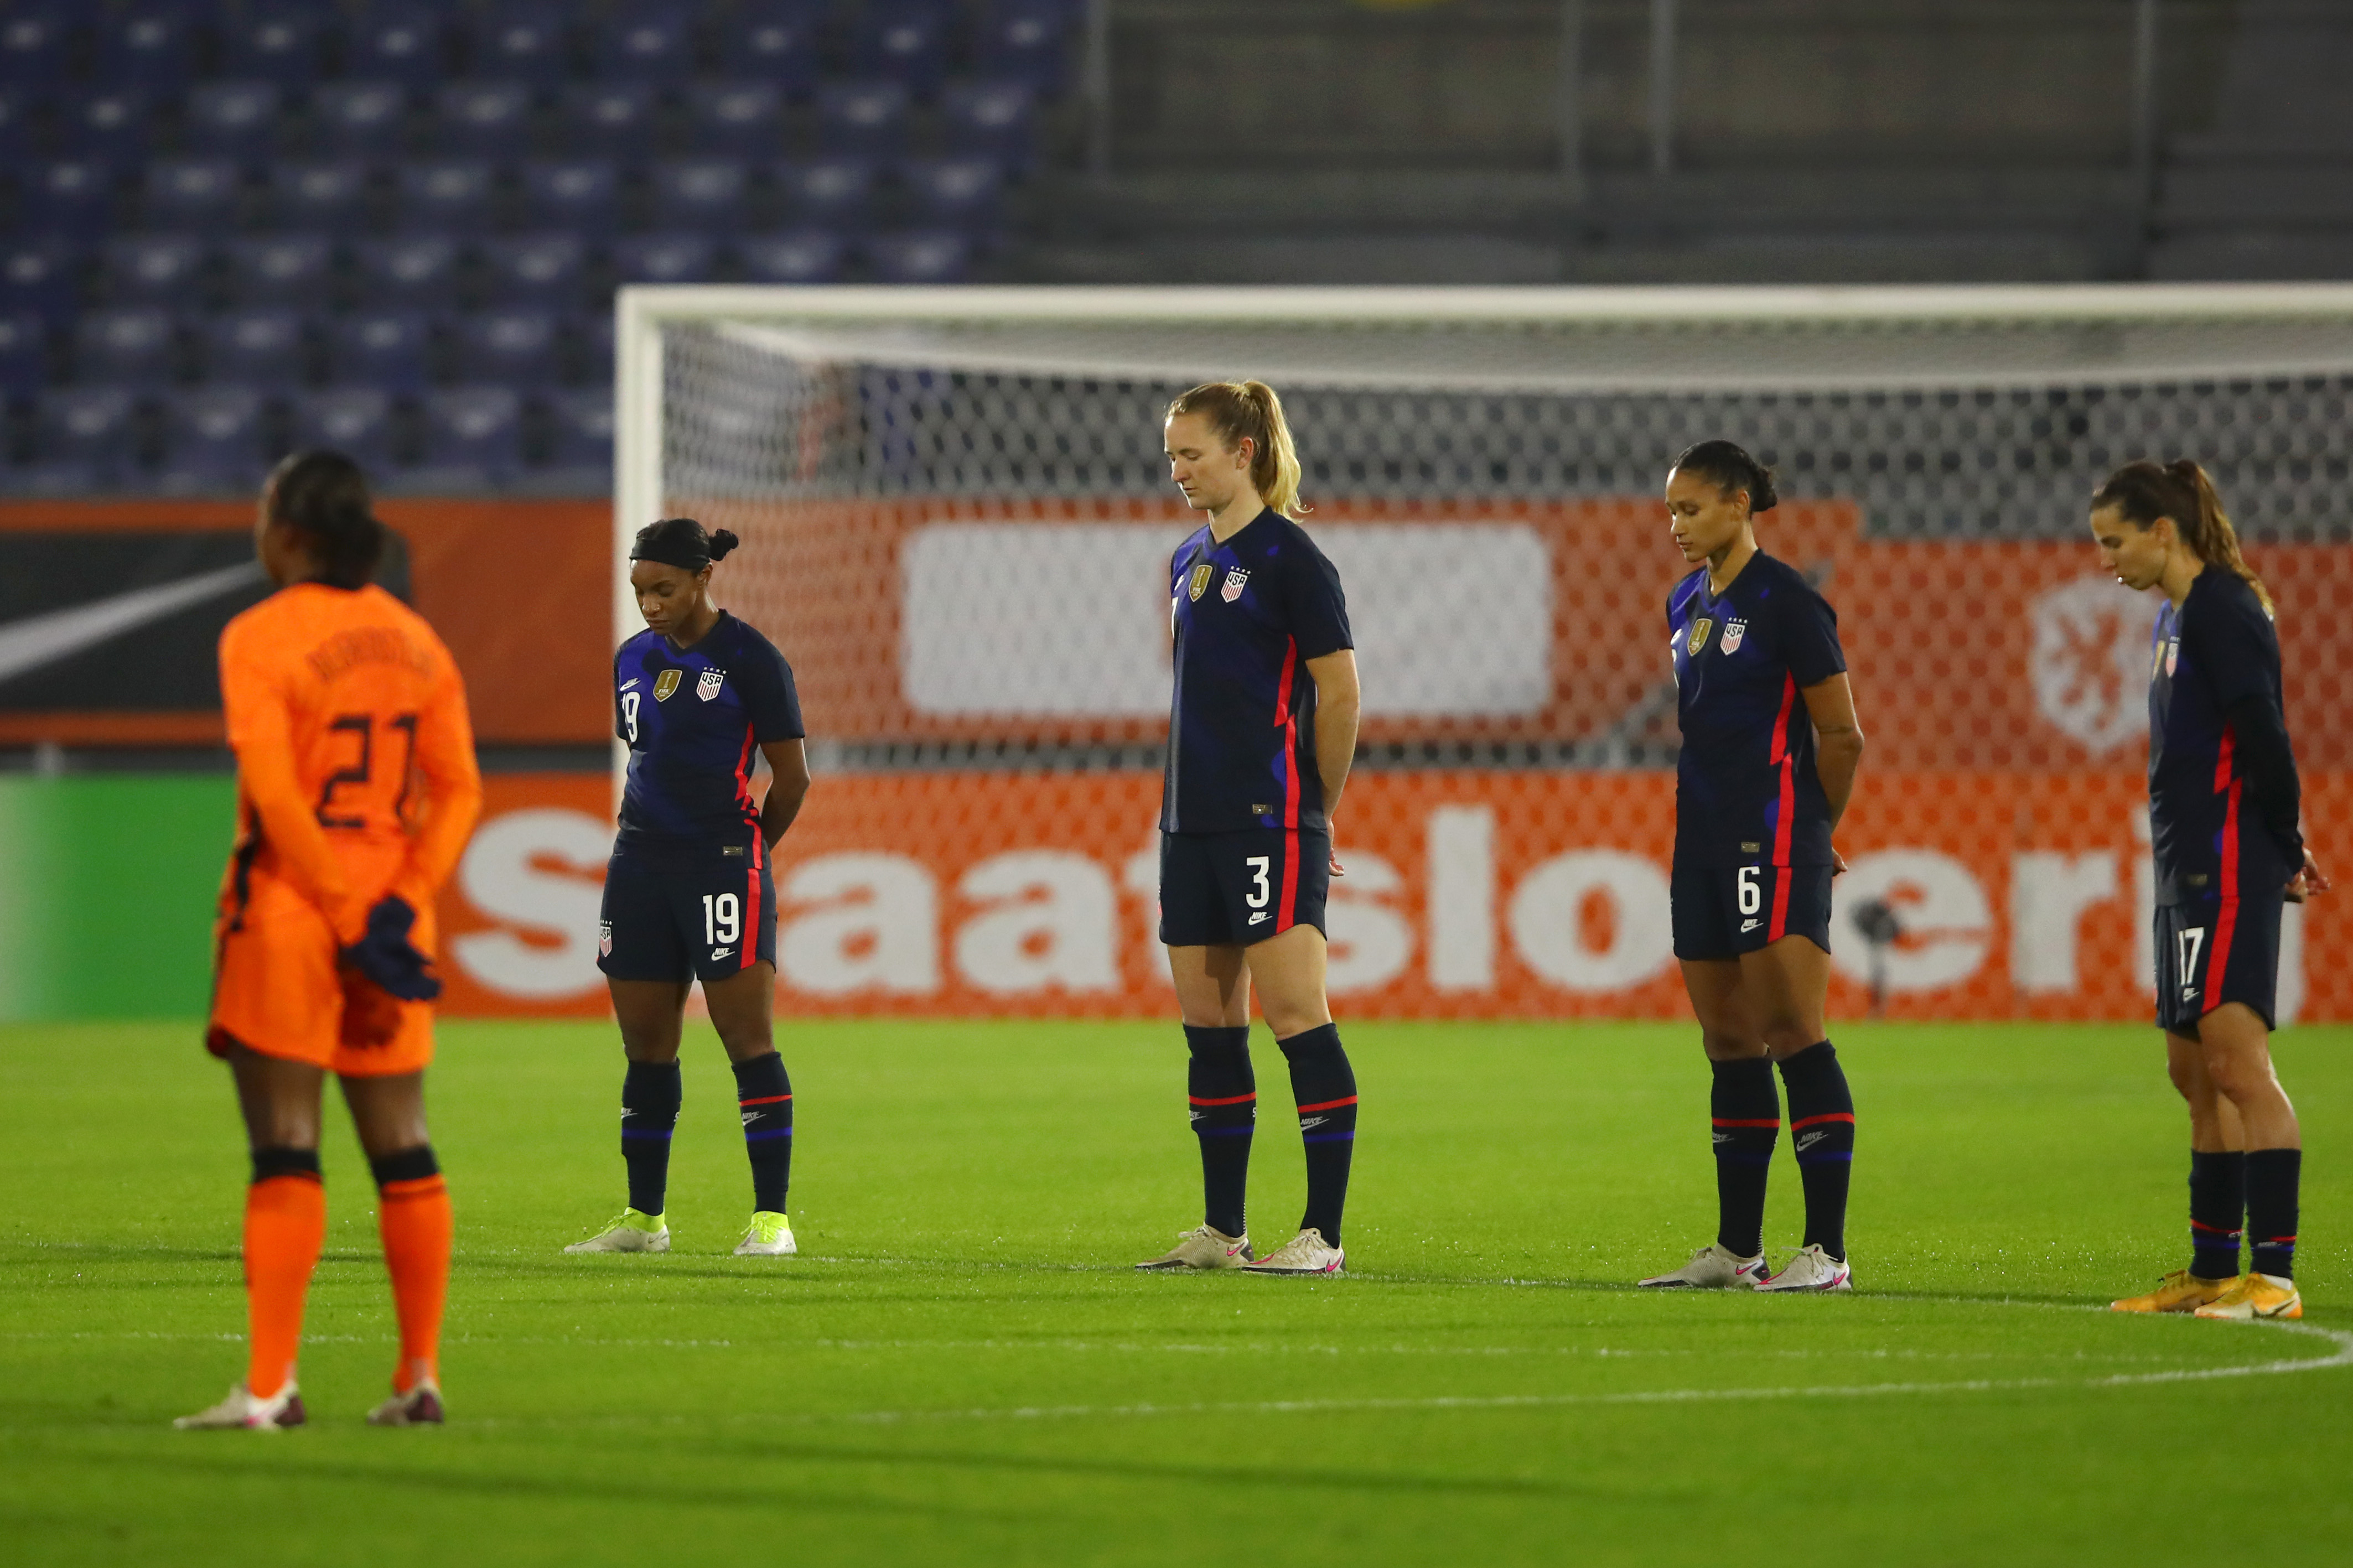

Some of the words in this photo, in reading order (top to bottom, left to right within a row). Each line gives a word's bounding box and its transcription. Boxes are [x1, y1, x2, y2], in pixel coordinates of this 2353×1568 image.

[1228, 573, 1245, 586] USA
[1726, 626, 1743, 637] USA
[702, 673, 723, 686] USA
[315, 714, 418, 831] 21
[1246, 855, 1269, 908] 3
[1738, 865, 1761, 915] 6
[703, 892, 740, 945] 19
[2178, 927, 2205, 986] 17
[1300, 1116, 1323, 1125] NIKE
[1801, 1130, 1823, 1142] NIKE
